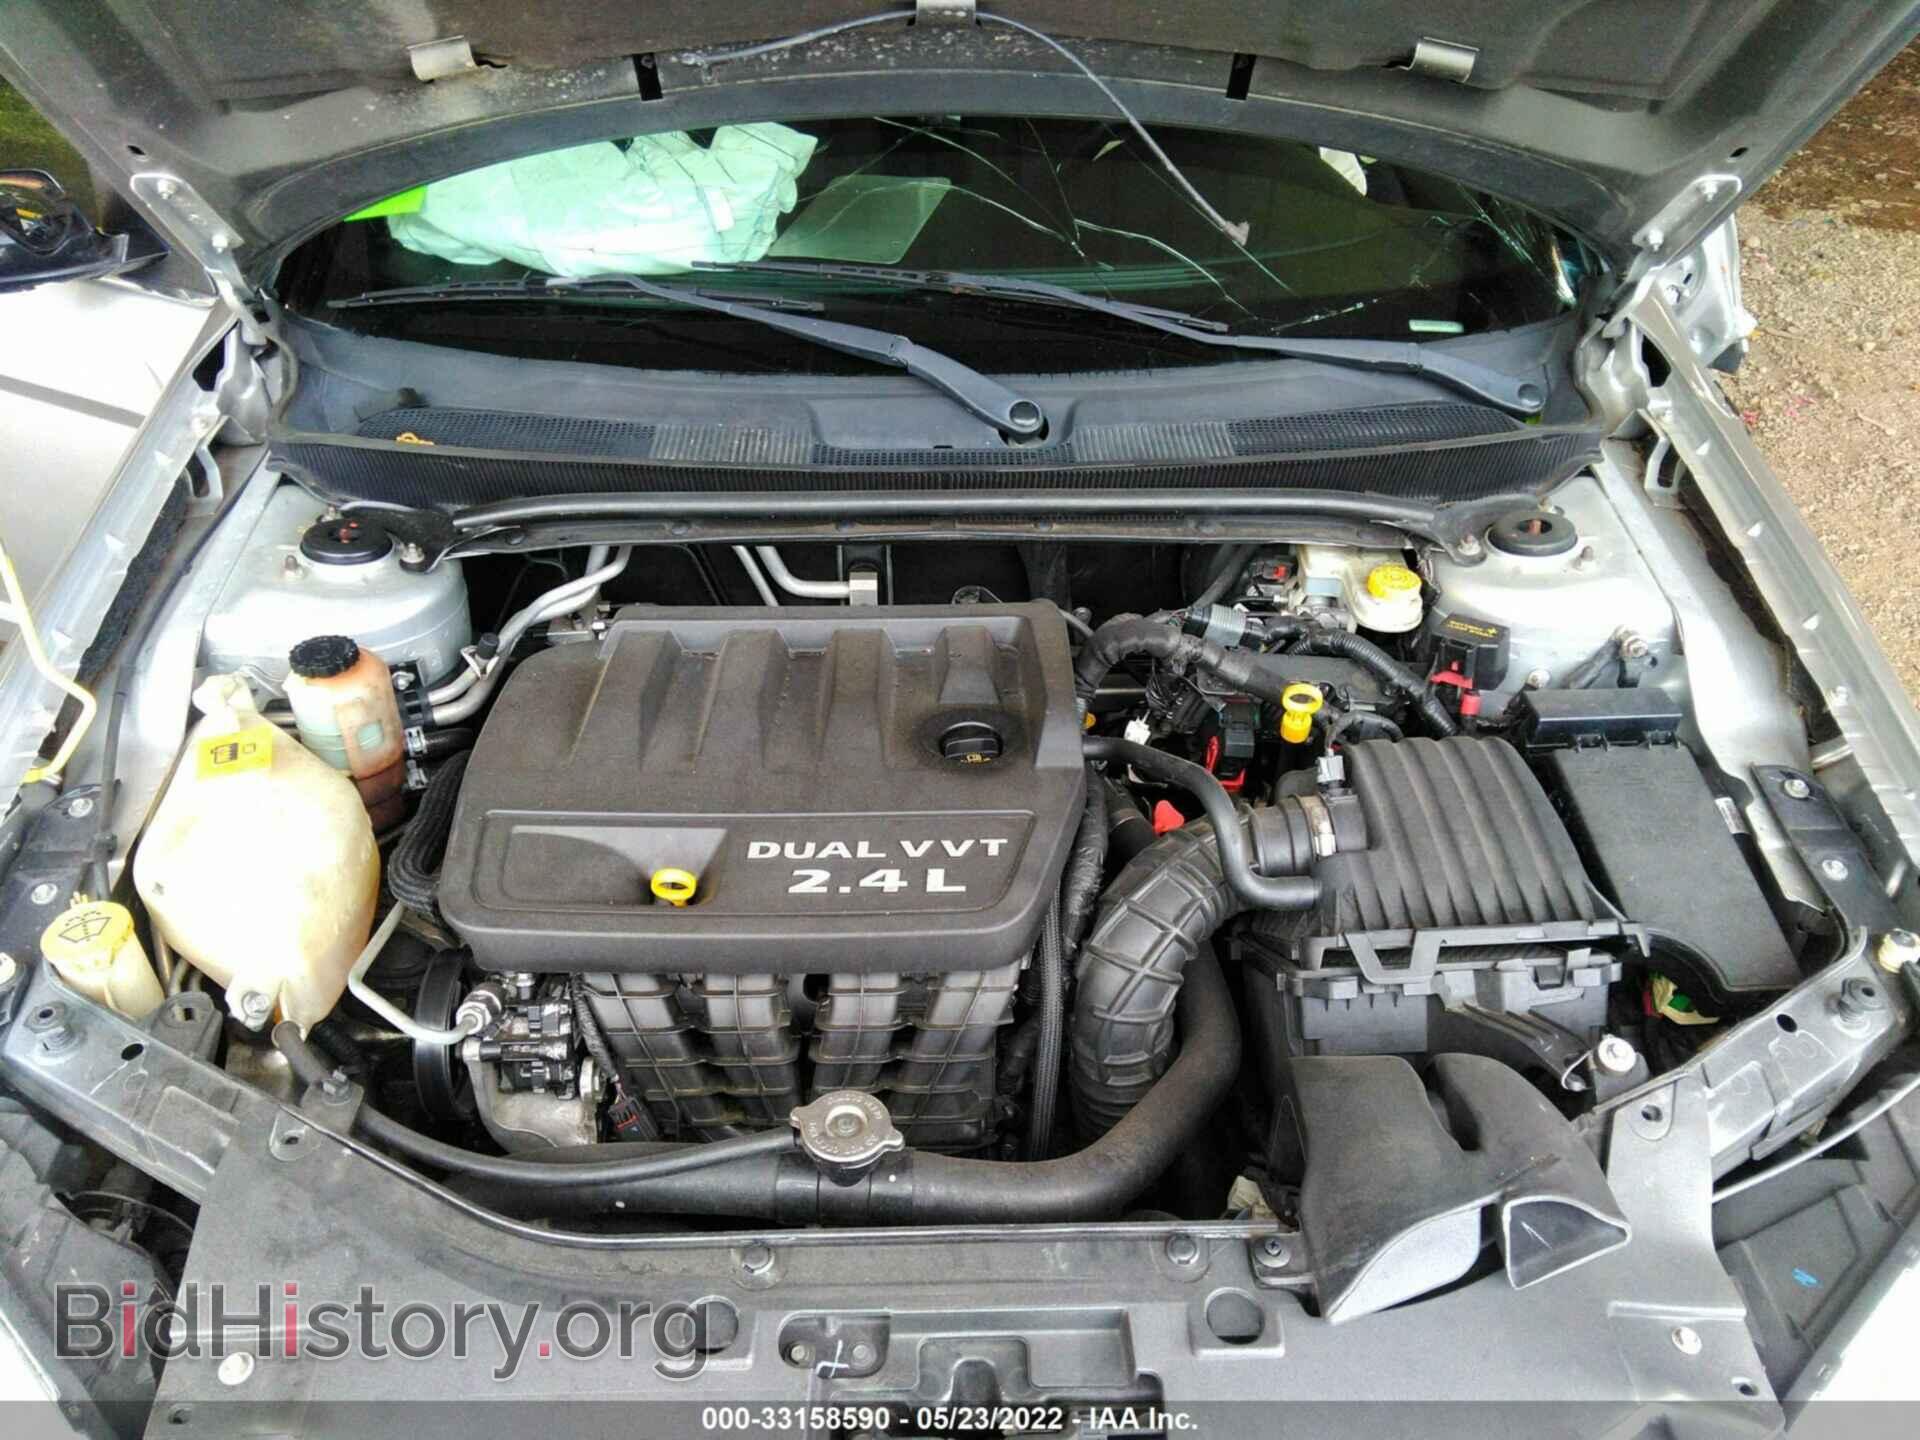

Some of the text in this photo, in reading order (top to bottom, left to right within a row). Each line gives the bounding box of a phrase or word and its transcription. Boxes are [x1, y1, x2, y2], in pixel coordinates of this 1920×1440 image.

[747, 838, 1009, 859] DUAL VVT
[788, 867, 967, 894] 2.4 L
